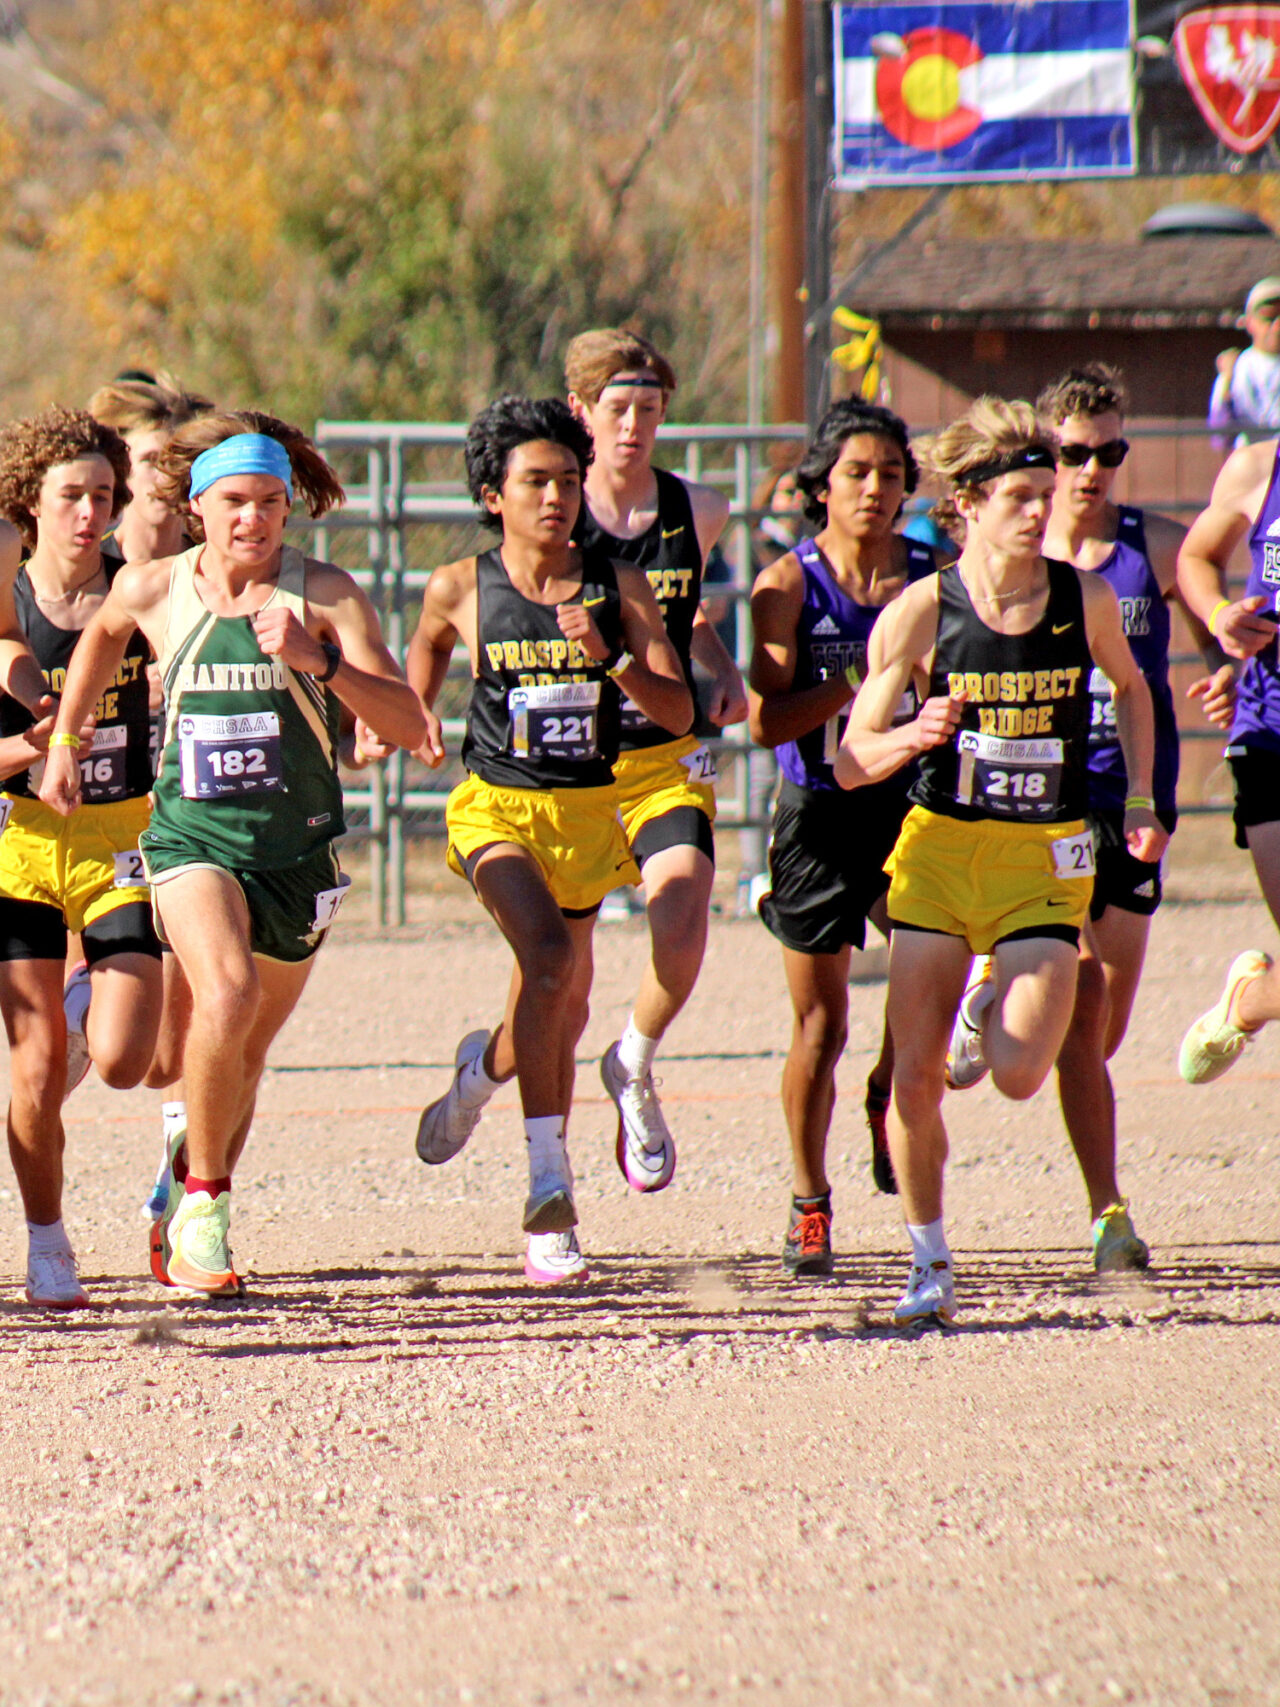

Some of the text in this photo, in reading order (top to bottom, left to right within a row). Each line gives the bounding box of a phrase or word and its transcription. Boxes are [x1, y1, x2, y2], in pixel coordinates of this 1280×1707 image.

[485, 639, 601, 671] PROSPE
[179, 663, 289, 692] MANITOU
[947, 667, 1081, 702] PROSPECT
[202, 716, 267, 735] CHSAA
[542, 716, 593, 742] 221
[978, 705, 1054, 736] RIDGE
[207, 748, 267, 776] 182
[988, 741, 1053, 758] CHSAA
[986, 770, 1047, 798] 218
